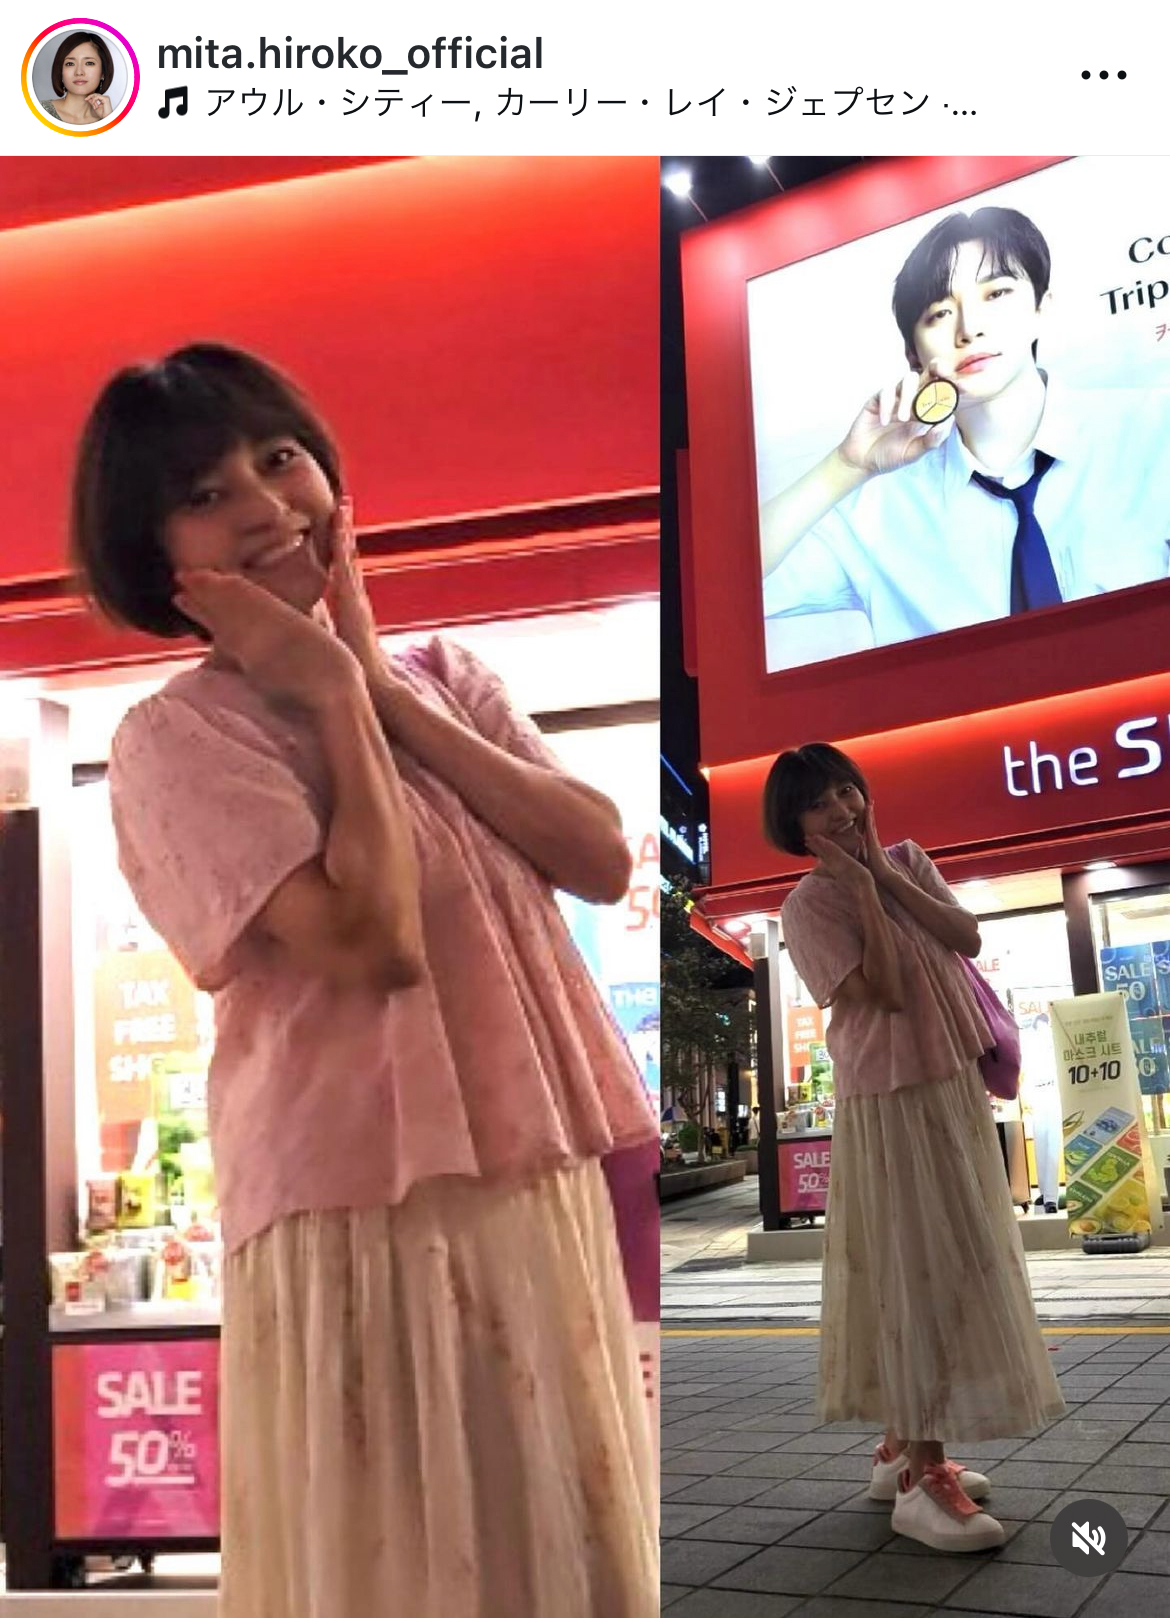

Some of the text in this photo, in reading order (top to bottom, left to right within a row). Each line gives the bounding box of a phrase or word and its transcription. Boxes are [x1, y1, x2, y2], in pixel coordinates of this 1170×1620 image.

[1099, 279, 1170, 316] Trip
[1003, 714, 1170, 797] the S
[976, 958, 1000, 973] ALE
[1104, 962, 1151, 982] SALE
[1063, 1042, 1123, 1062] 마스크 시트
[1068, 1059, 1121, 1085] 10+10
[793, 1151, 830, 1169] SALE
[97, 1371, 203, 1419] SALE
